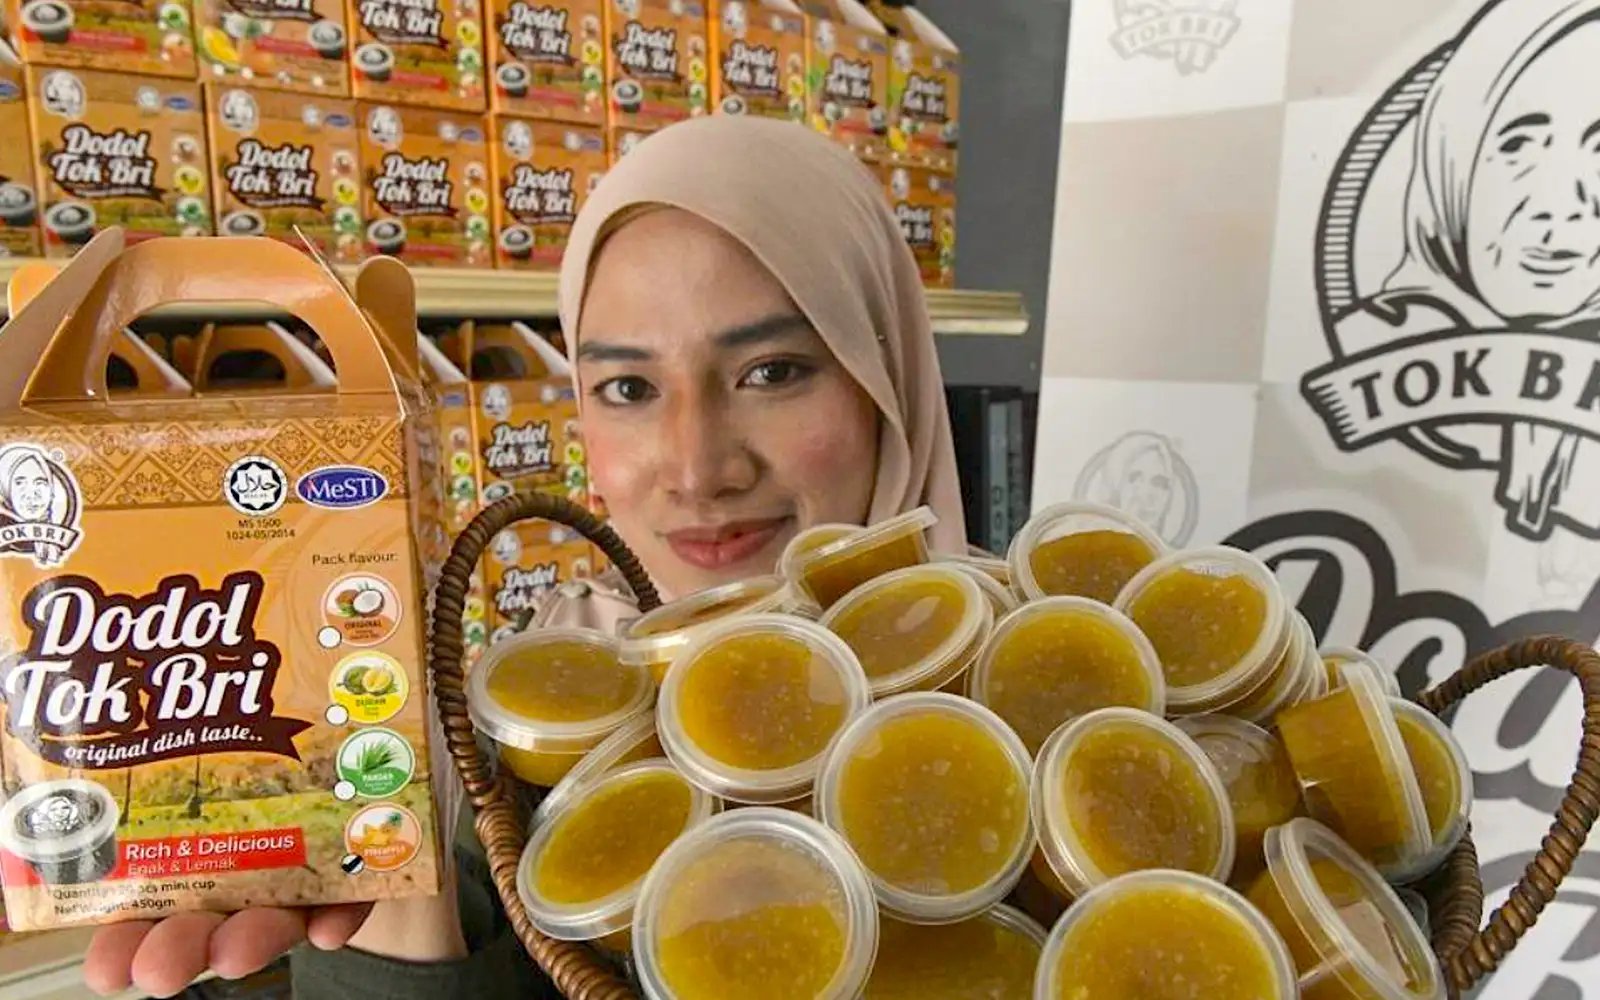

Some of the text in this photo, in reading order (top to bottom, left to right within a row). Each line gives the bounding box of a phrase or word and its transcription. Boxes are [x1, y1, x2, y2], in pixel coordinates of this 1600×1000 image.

[63, 126, 148, 157] Dodol
[51, 153, 154, 185] Tok Bri
[239, 141, 310, 170] Dodol
[383, 154, 446, 181] Dodol
[227, 165, 316, 196] Tok Bri
[1350, 347, 1492, 421] TOK
[306, 477, 378, 500] MeSTI
[33, 525, 66, 541] BRI
[238, 518, 282, 528] MS 1500
[312, 553, 345, 565] Pack
[35, 583, 250, 656] Dodol
[5, 651, 270, 727] Tok Bri
[64, 739, 148, 767] original
[152, 729, 196, 754] dish
[126, 834, 295, 861] Rich & Delicious
[128, 856, 237, 877] Enak & Lemak
[161, 880, 190, 892] mini
[192, 879, 216, 892] cup
[132, 898, 177, 911] 450gm
